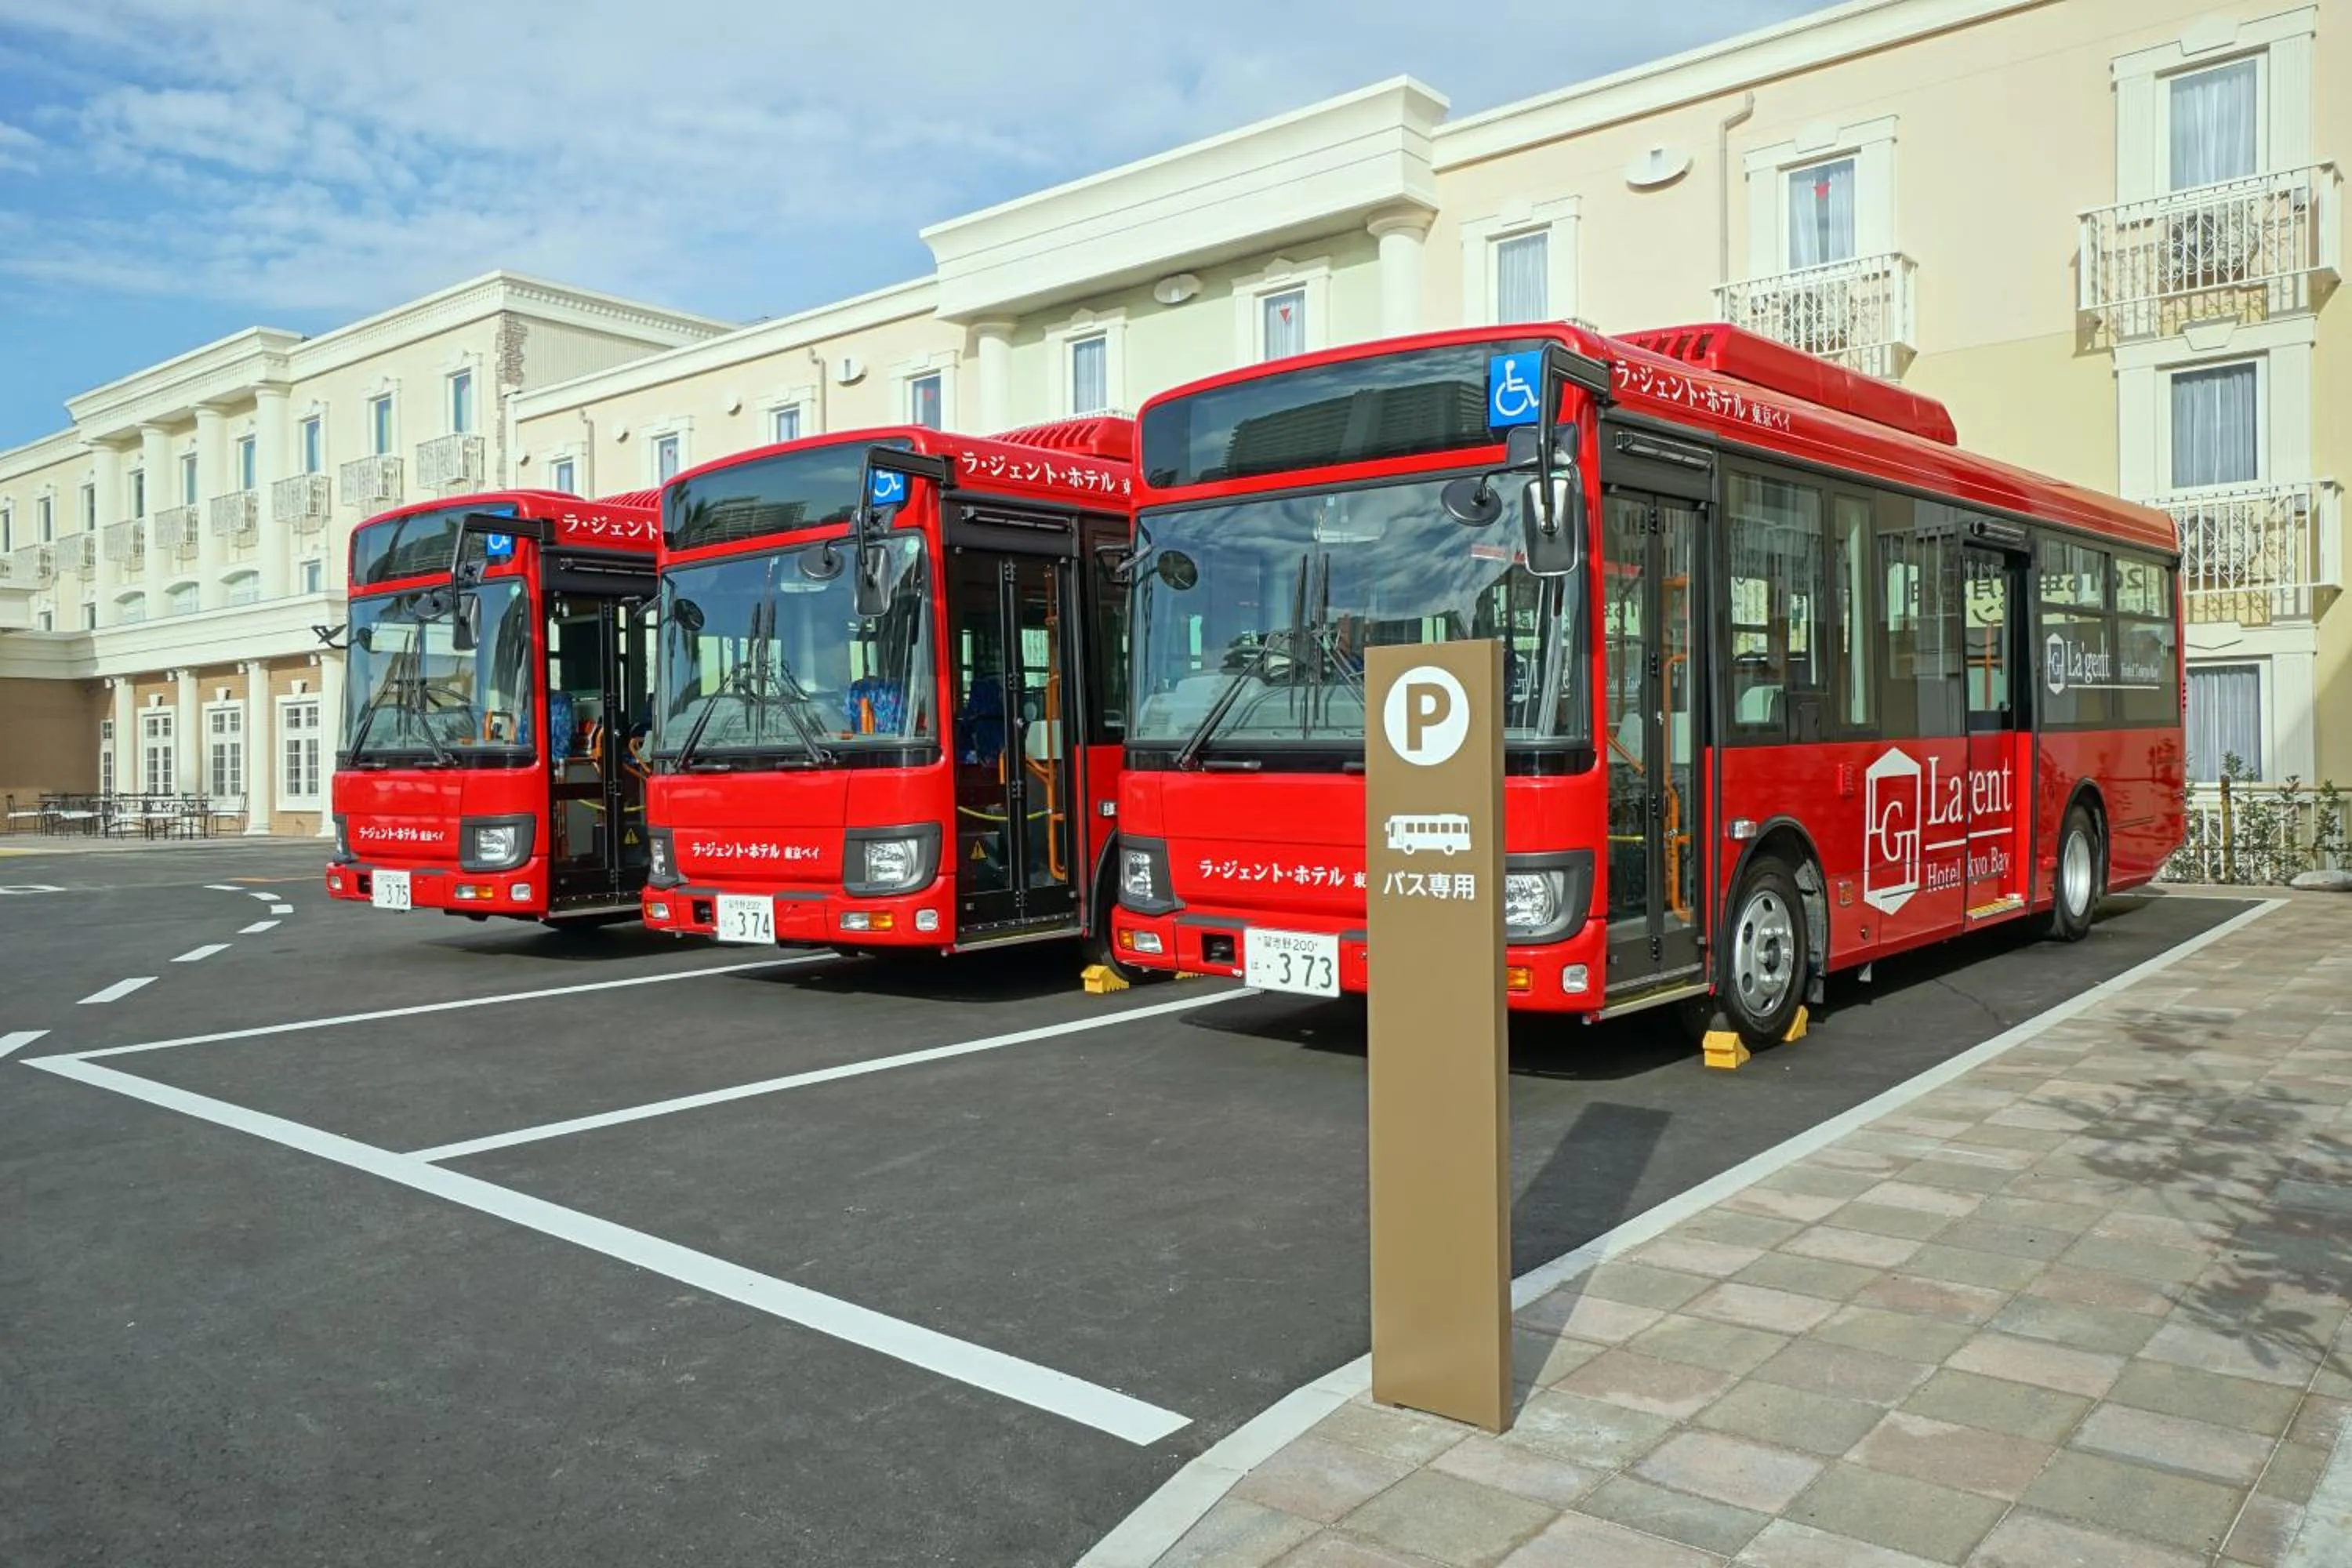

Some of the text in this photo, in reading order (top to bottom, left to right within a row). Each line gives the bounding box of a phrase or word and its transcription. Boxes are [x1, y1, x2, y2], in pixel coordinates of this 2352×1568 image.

[1406, 681, 1451, 751] P
[1383, 870, 1475, 900] バス専用
[1926, 858, 1961, 892] Hotel
[1991, 846, 2011, 879] Bay
[387, 883, 408, 905] 375
[738, 911, 770, 938] 374
[1279, 953, 1332, 989] 373
